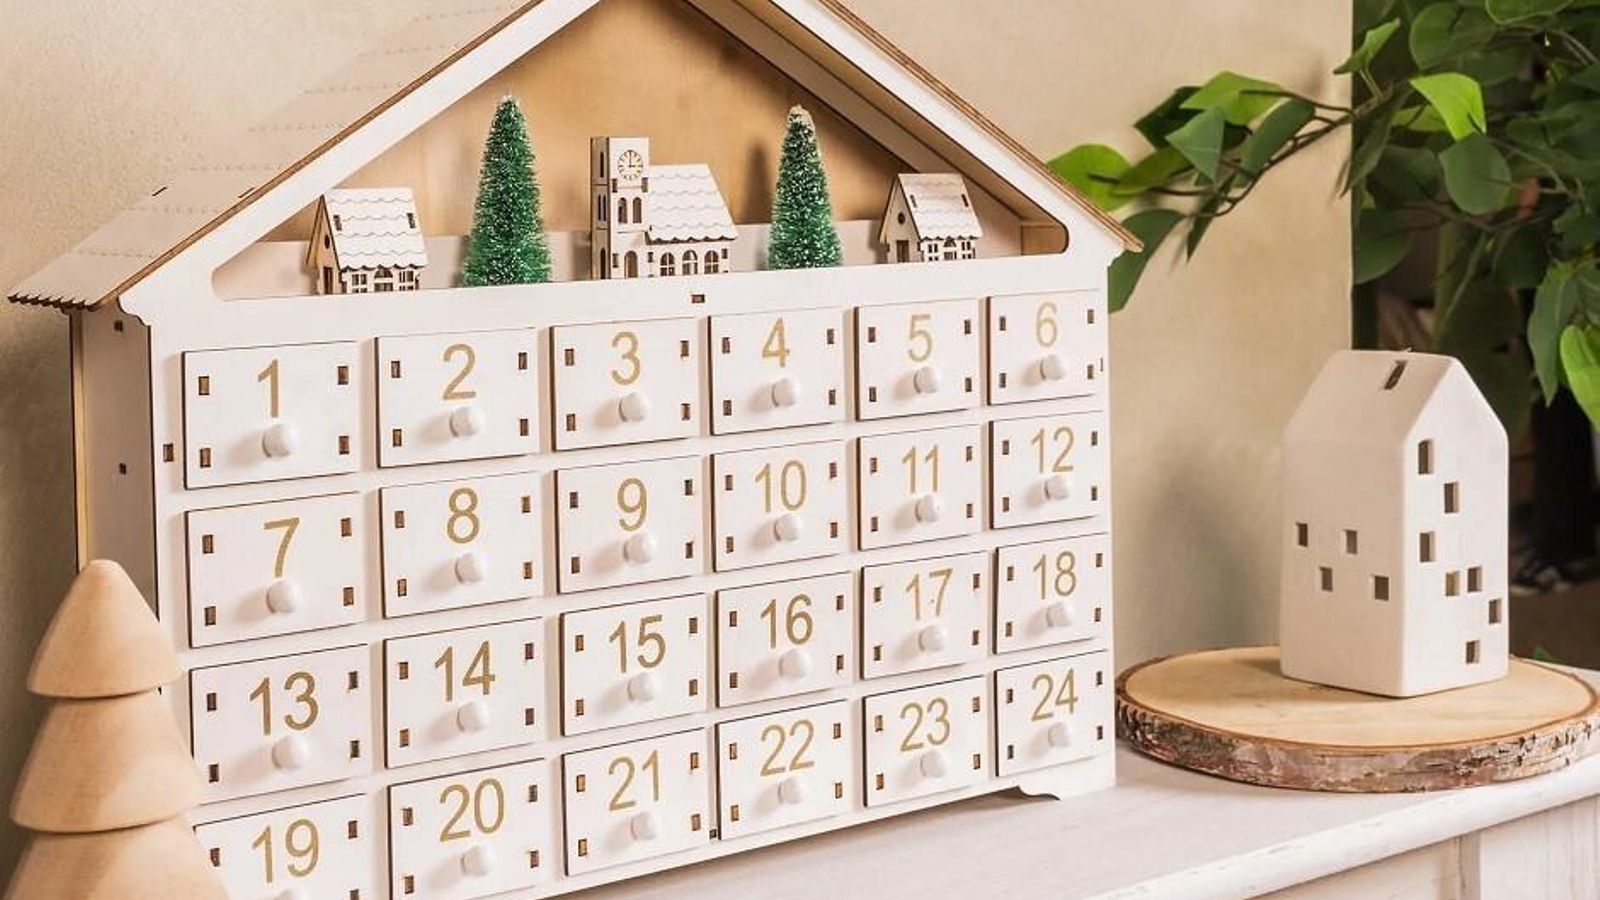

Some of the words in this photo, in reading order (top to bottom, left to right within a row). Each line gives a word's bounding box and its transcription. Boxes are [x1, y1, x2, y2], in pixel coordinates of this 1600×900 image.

[762, 319, 790, 368] 4
[909, 315, 932, 361] 5
[1037, 303, 1057, 346] 6
[443, 344, 475, 400] 2
[612, 332, 640, 385] 3
[257, 359, 279, 418] 1
[902, 446, 938, 493] 11
[1032, 427, 1074, 472] 12
[617, 478, 647, 531] 9
[755, 460, 806, 512] 10
[447, 488, 480, 544] 8
[264, 517, 299, 578] 7
[907, 568, 953, 619] 17
[1035, 551, 1076, 599] 18
[610, 615, 666, 673] 15
[761, 594, 813, 648] 16
[435, 641, 495, 701] 14
[1032, 669, 1078, 721] 24
[250, 672, 318, 735] 13
[900, 698, 950, 752] 23
[761, 720, 814, 776] 22
[609, 750, 661, 811] 21
[440, 779, 504, 842] 20
[252, 819, 319, 883] 19
